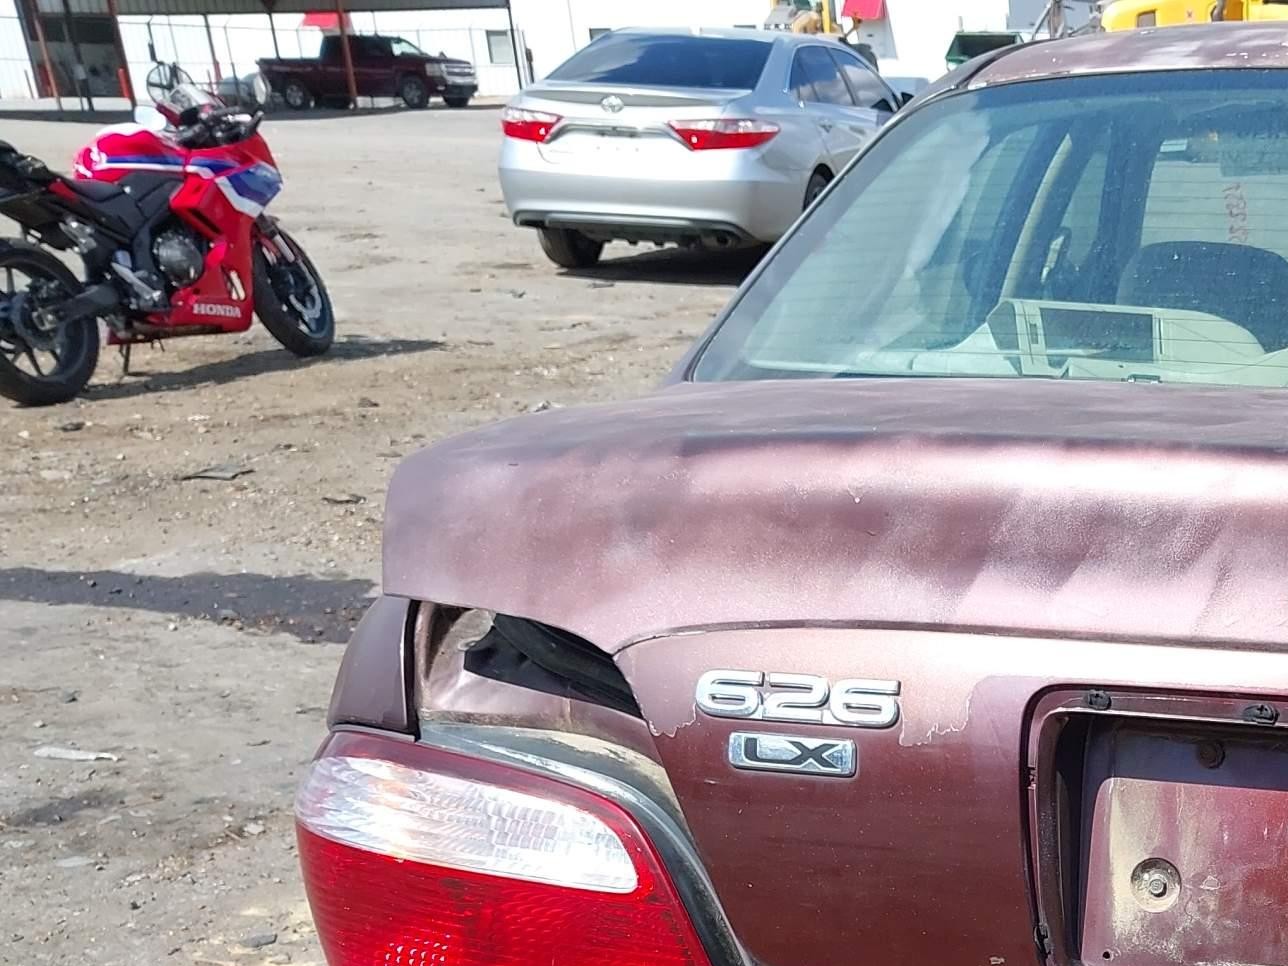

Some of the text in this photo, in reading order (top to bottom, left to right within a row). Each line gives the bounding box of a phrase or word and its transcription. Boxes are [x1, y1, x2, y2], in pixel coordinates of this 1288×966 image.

[192, 302, 242, 318] HONDA
[695, 669, 901, 729] 626
[743, 735, 843, 770] LX
